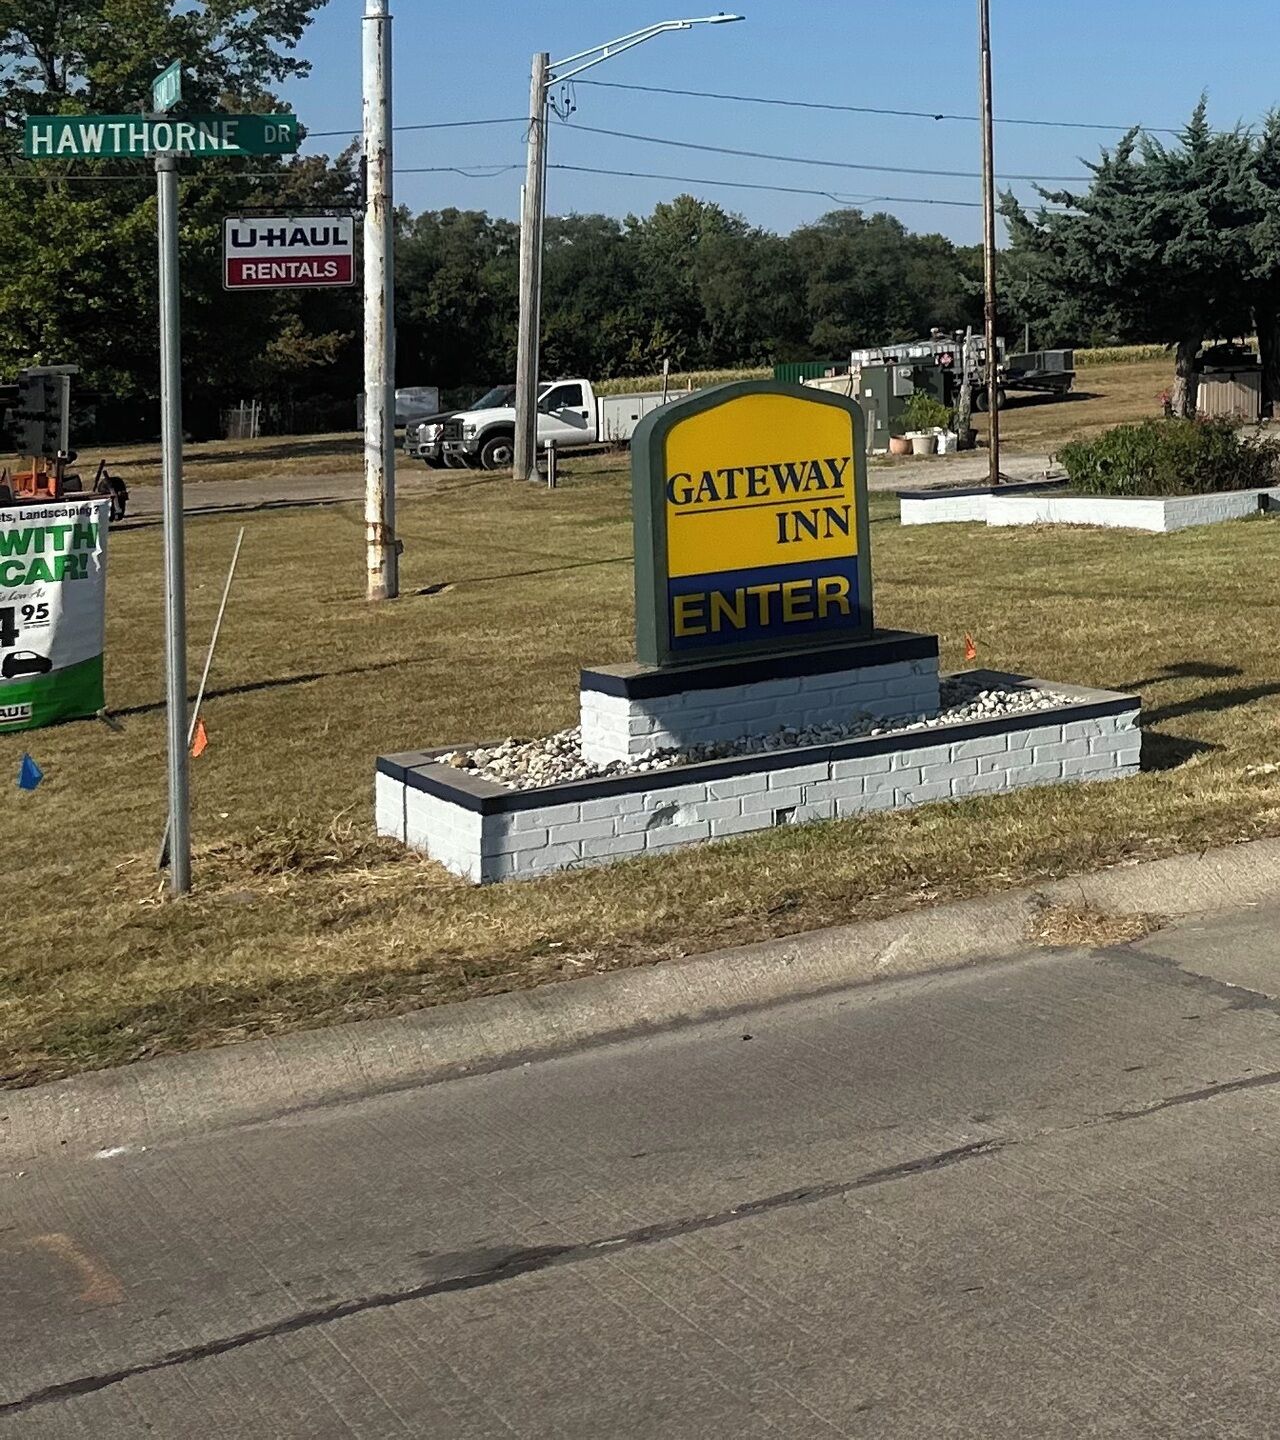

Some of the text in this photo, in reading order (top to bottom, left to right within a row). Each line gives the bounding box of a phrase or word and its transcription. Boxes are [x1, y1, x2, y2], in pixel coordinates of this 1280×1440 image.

[31, 120, 291, 155] HAWTHORNE DR
[231, 226, 348, 248] U-HAUL
[241, 261, 338, 280] RENTALS
[667, 457, 851, 506] GATEWAY
[0, 522, 99, 557] WITH
[776, 504, 851, 545] INN
[0, 552, 89, 588] CAR!
[21, 602, 49, 622] 95
[672, 575, 851, 638] ENTER
